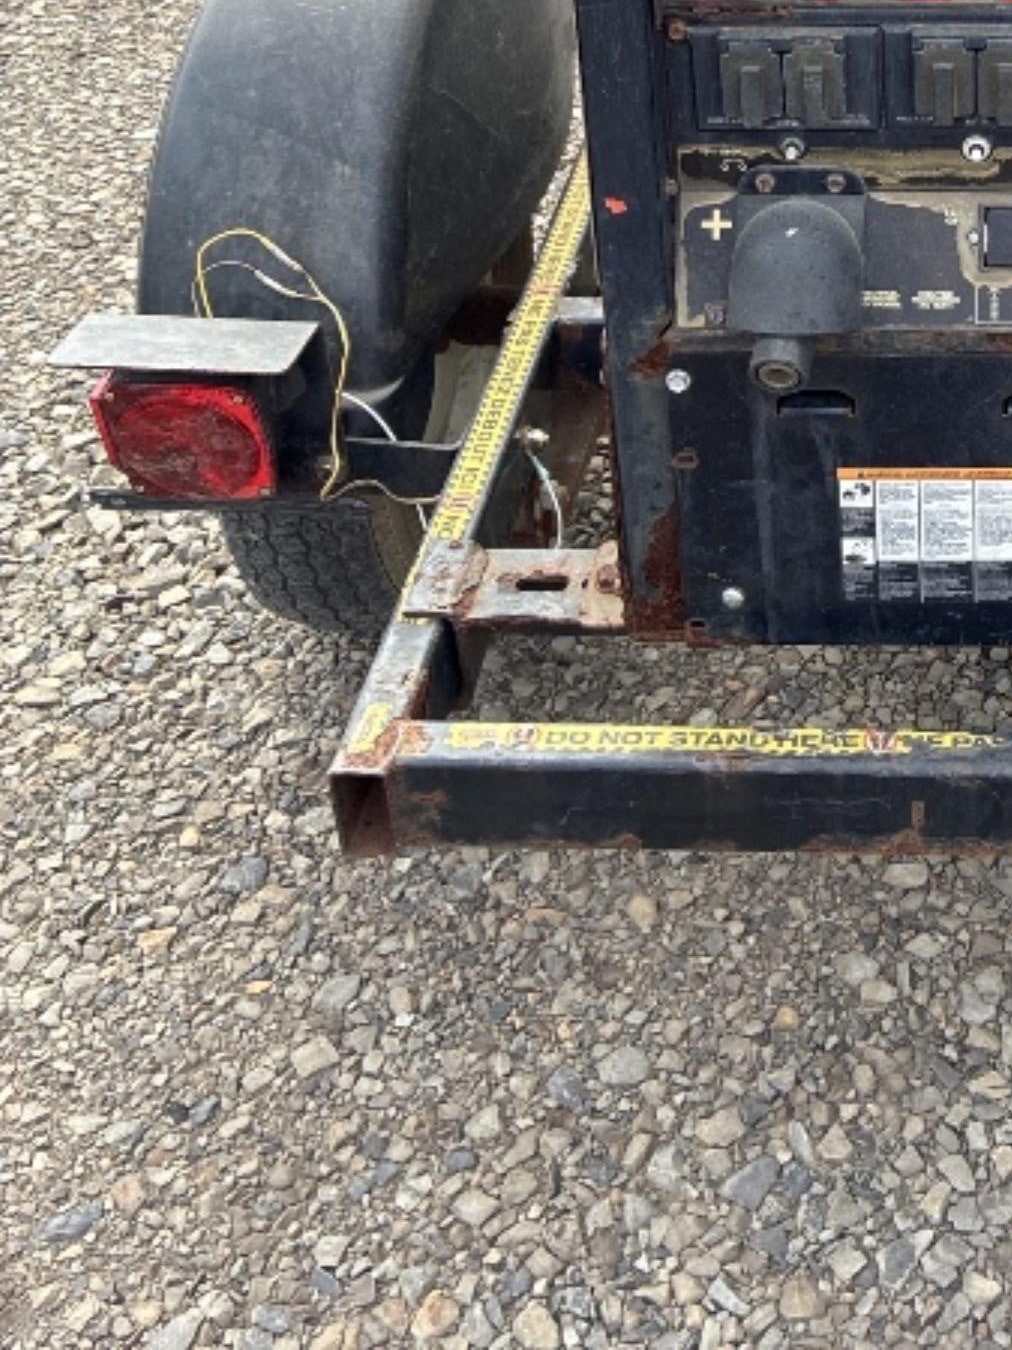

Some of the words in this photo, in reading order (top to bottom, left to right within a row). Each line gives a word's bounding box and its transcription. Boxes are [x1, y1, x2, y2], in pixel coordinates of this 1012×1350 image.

[473, 398, 507, 461] DEBOUT
[545, 730, 591, 745] DO
[599, 730, 663, 746] NOT
[668, 731, 768, 748] STAND
